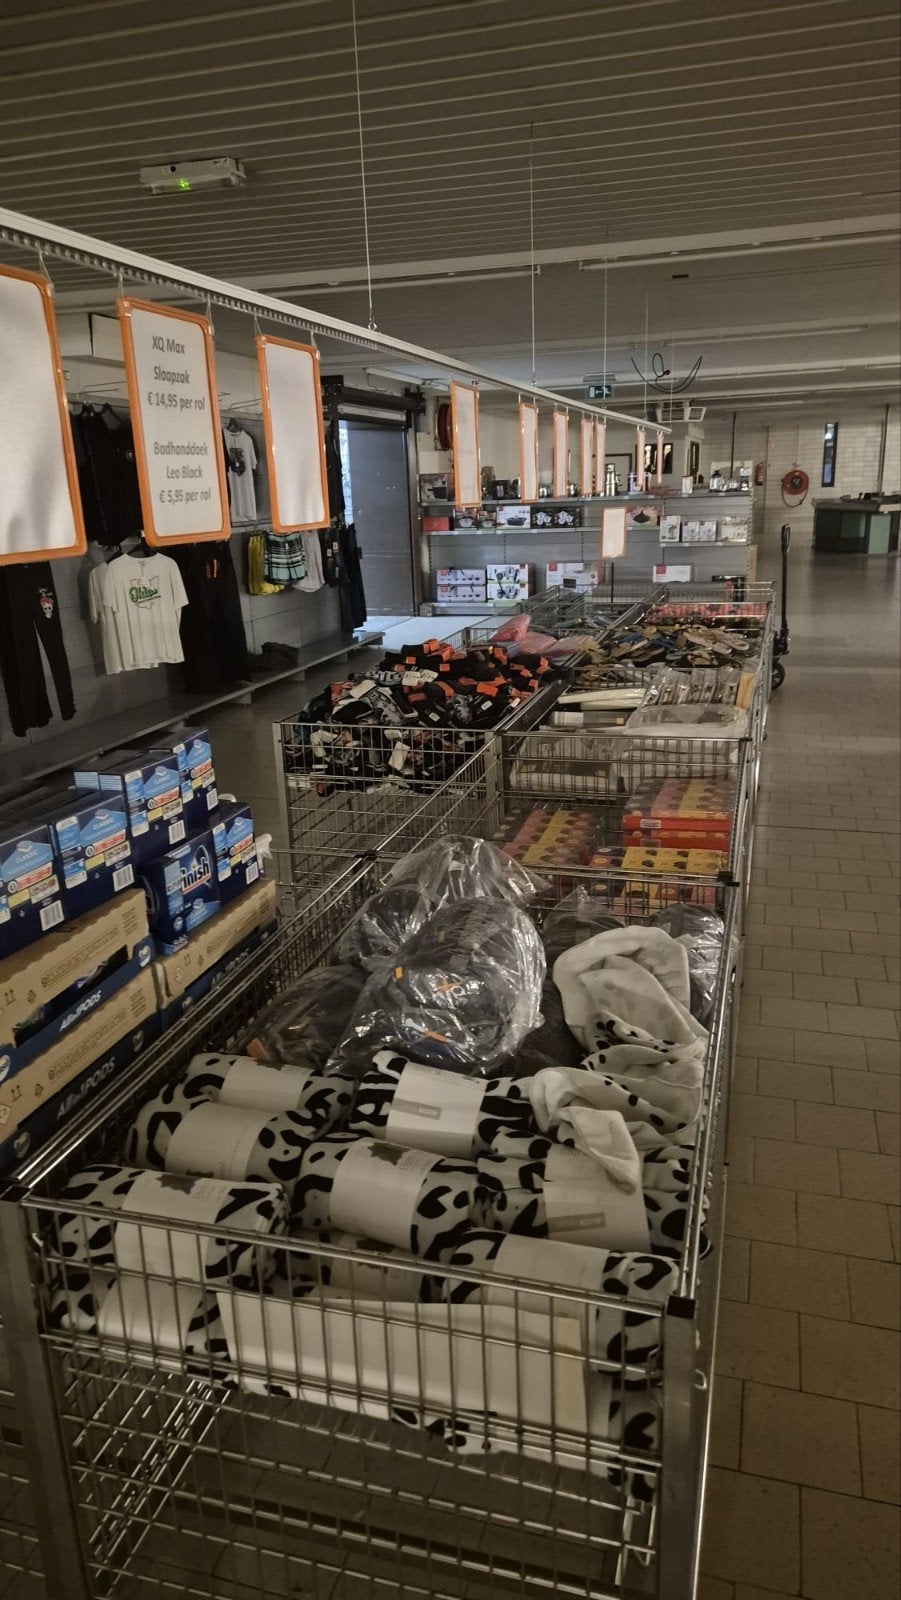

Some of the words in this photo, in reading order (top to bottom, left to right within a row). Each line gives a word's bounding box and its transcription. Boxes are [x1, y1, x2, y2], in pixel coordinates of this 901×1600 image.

[152, 335, 166, 352] XQ
[166, 338, 185, 354] Max
[153, 366, 190, 385] Slaapzak
[147, 391, 154, 405] €
[155, 392, 178, 409] 14,95
[179, 398, 192, 411] per
[194, 396, 205, 410] rol
[154, 441, 208, 456] Badhanddoek
[181, 464, 203, 479] Black
[159, 490, 166, 503] €
[167, 489, 184, 505] 5,95
[185, 491, 199, 504] per
[200, 486, 211, 501] rol
[180, 856, 211, 891] inish
